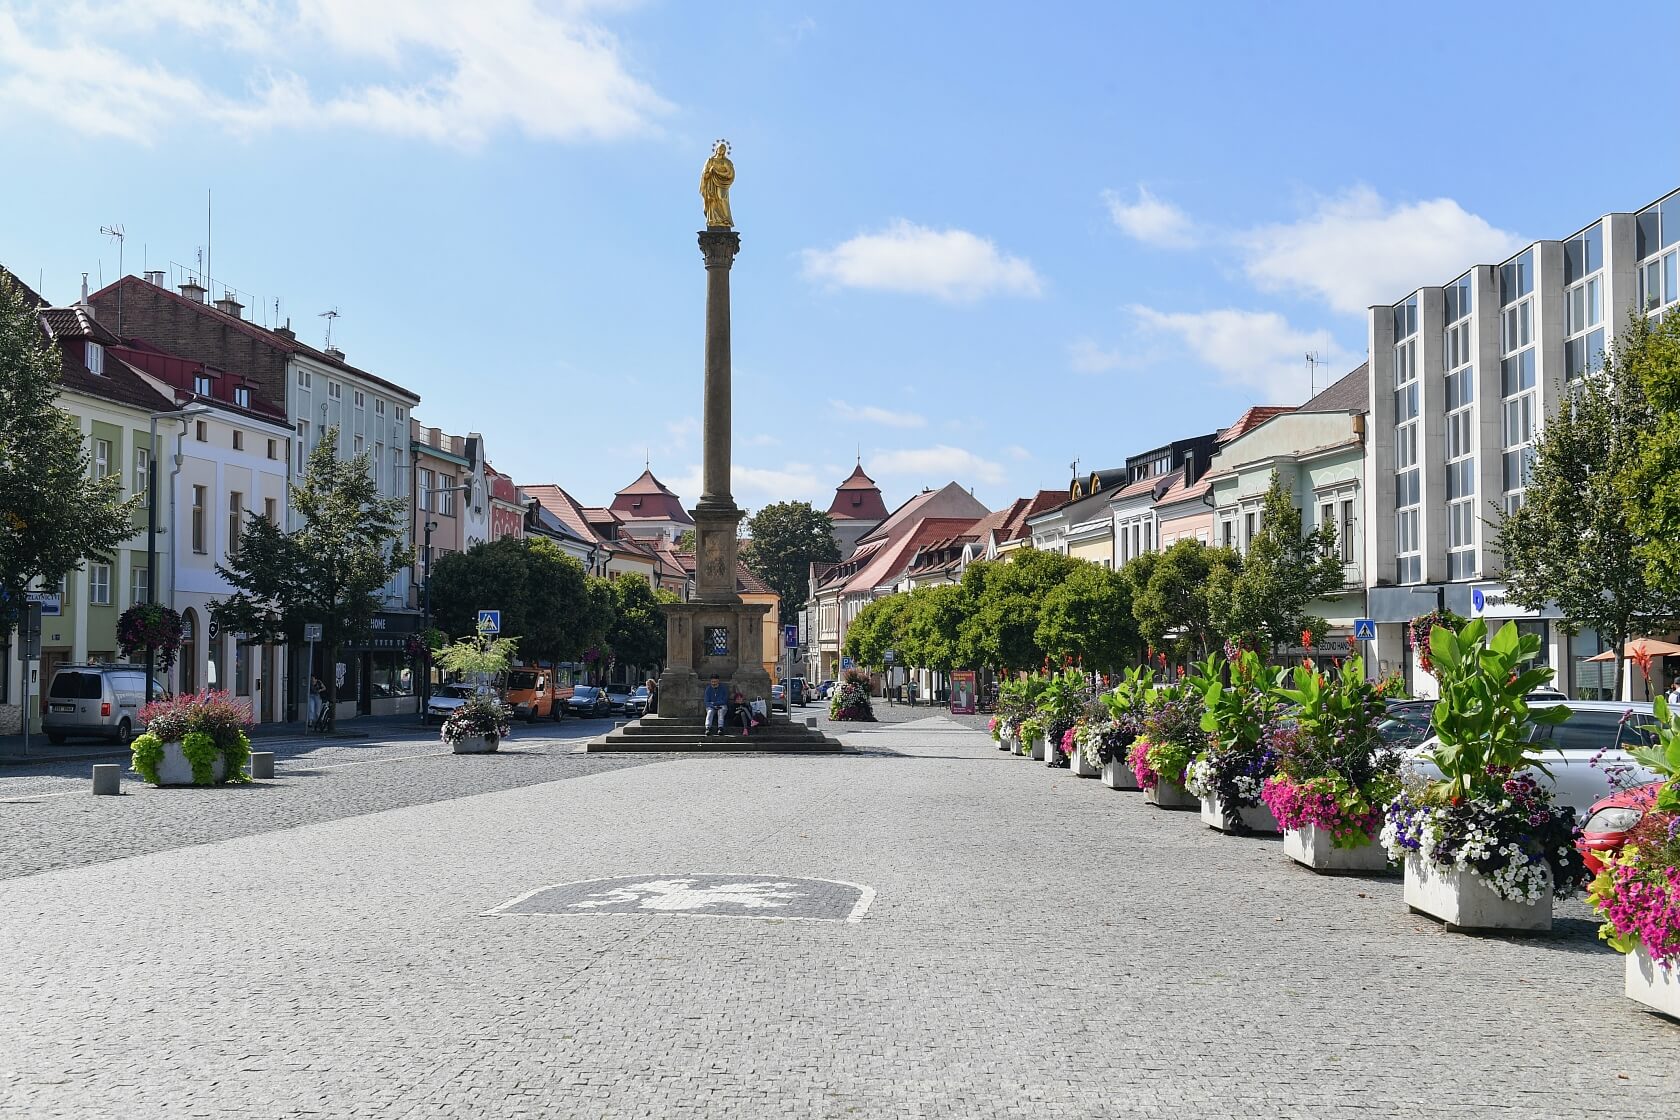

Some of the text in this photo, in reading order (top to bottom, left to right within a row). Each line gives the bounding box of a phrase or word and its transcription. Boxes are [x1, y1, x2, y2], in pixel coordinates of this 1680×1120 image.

[370, 618, 386, 630] HOME
[1319, 641, 1337, 651] SECOND
[843, 658, 849, 666] P
